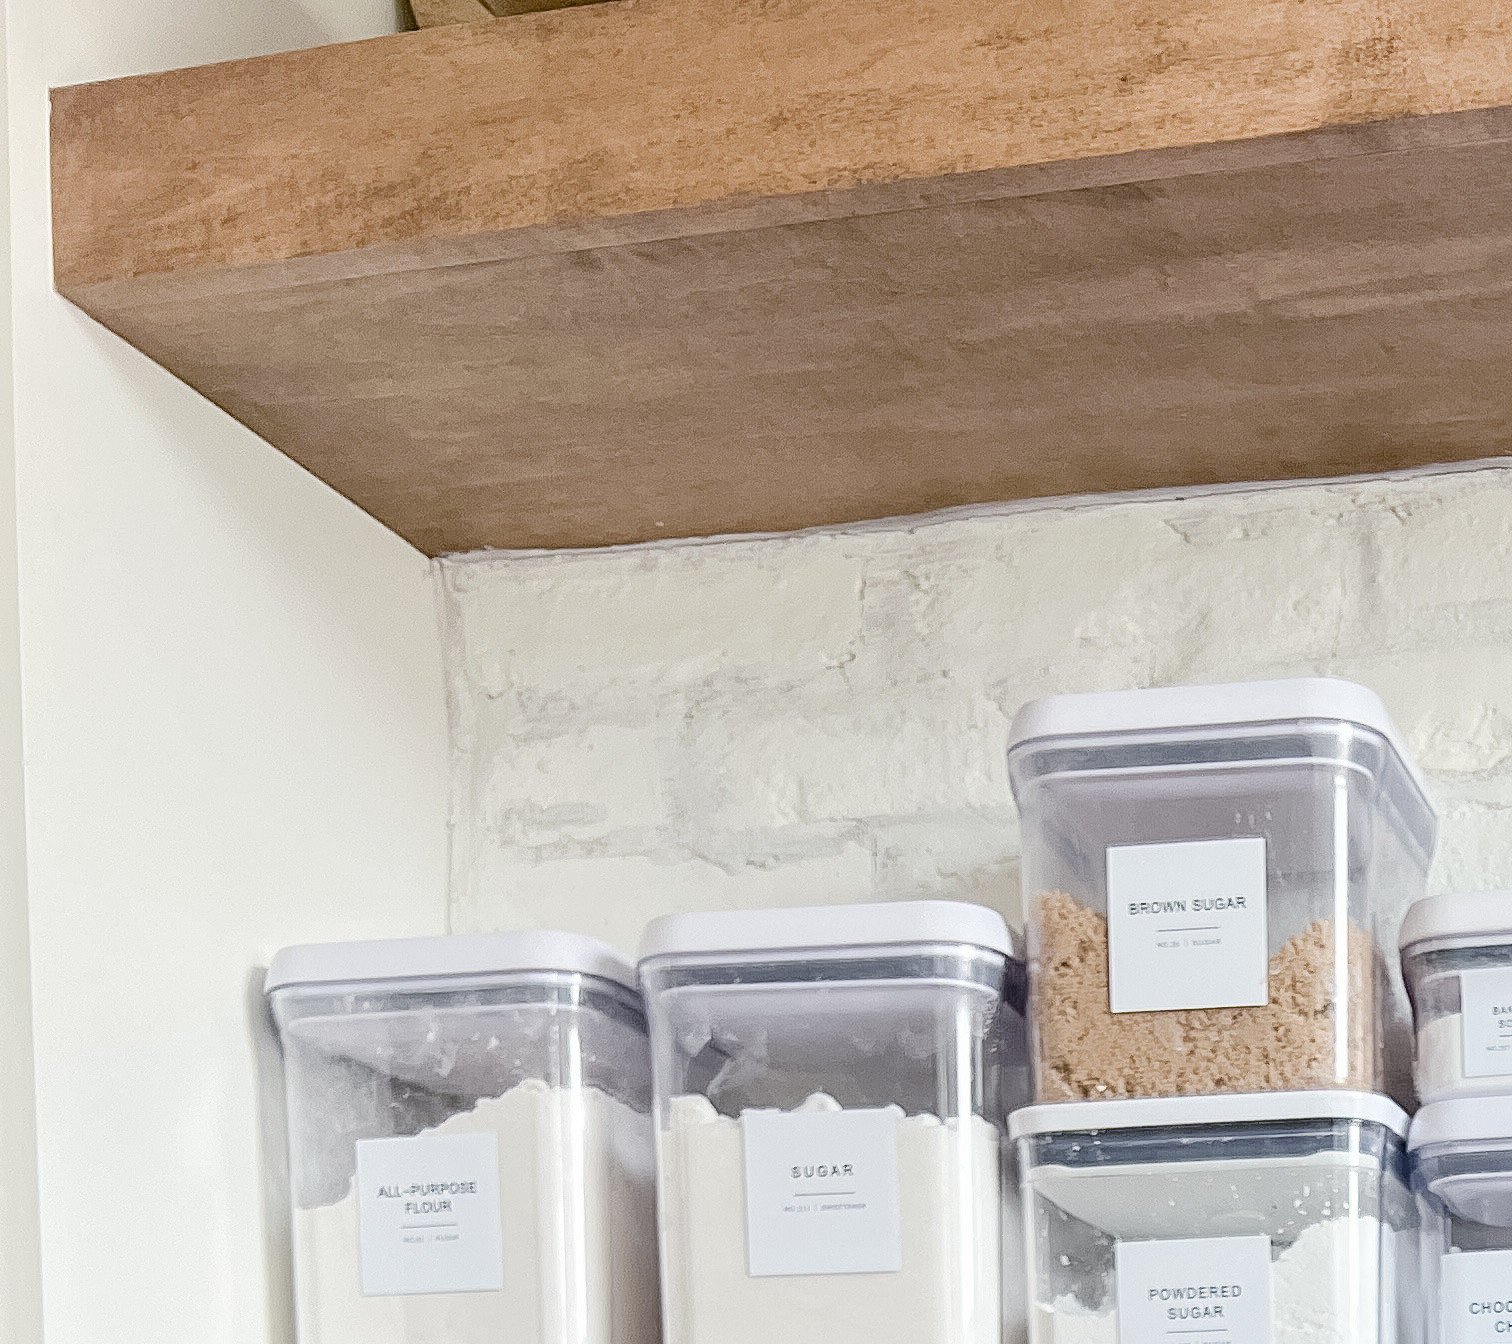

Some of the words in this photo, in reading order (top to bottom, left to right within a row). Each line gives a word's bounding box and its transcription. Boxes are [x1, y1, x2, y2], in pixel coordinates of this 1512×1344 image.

[1128, 900, 1187, 916] BROWN
[1191, 896, 1247, 912] SUGAR
[790, 1163, 855, 1179] SUGAR
[376, 1180, 478, 1198] ALL-PURPOSE
[404, 1199, 453, 1215] FLOUR
[1148, 1285, 1243, 1301] POWDERED
[1166, 1305, 1225, 1320] SUGAR
